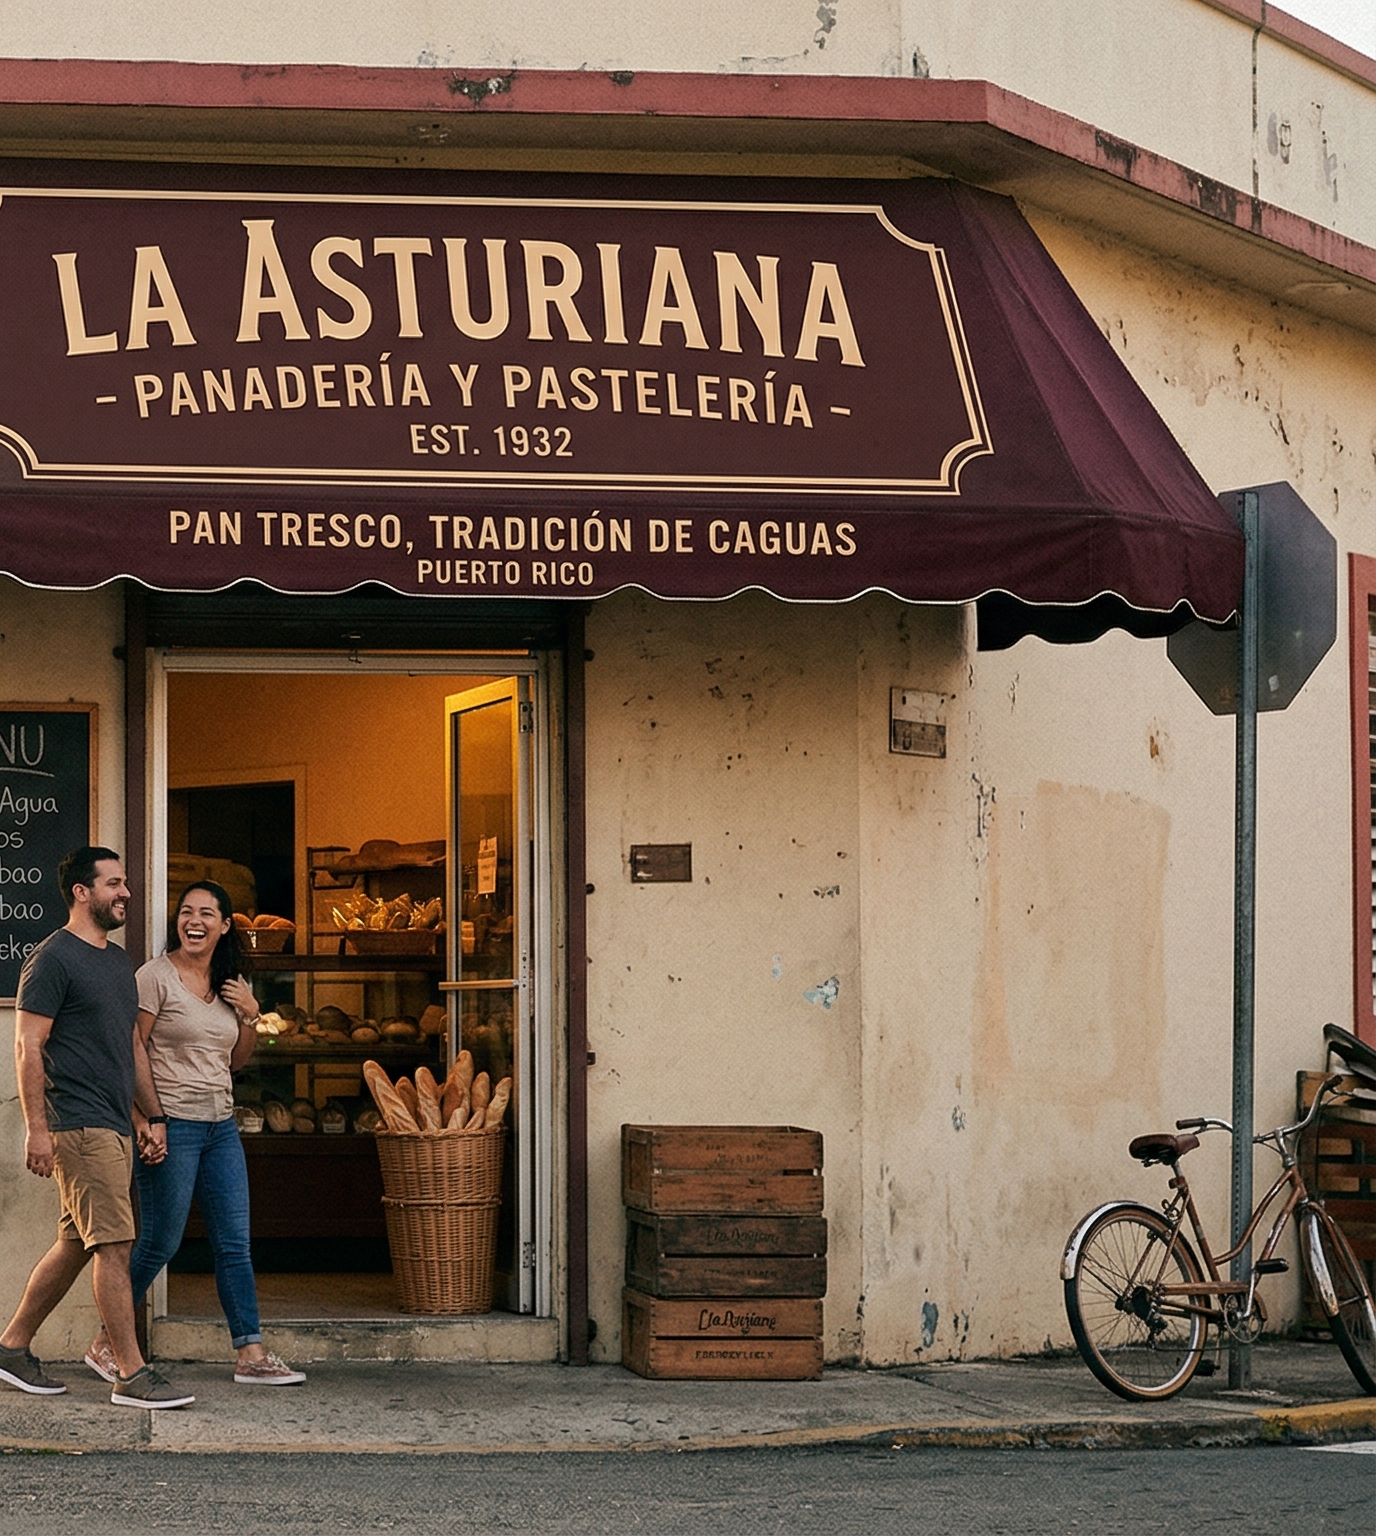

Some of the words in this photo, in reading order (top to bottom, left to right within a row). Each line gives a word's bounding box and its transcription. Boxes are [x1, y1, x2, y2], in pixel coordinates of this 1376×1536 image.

[51, 245, 198, 356] LA
[235, 219, 866, 367] ASTURIANA
[135, 353, 431, 418] PANADERÍA
[448, 363, 479, 407] Y
[502, 365, 814, 429] PASTELERÍA
[410, 424, 480, 455] EST.
[493, 425, 573, 457] 1932
[169, 510, 242, 545] PAN
[256, 512, 414, 555] TRESCO,
[428, 509, 632, 553] TRADICIÓN
[648, 519, 694, 553] DE
[709, 519, 857, 556] CAGUAS
[417, 559, 520, 585] PUERTO
[532, 561, 594, 586] RICO
